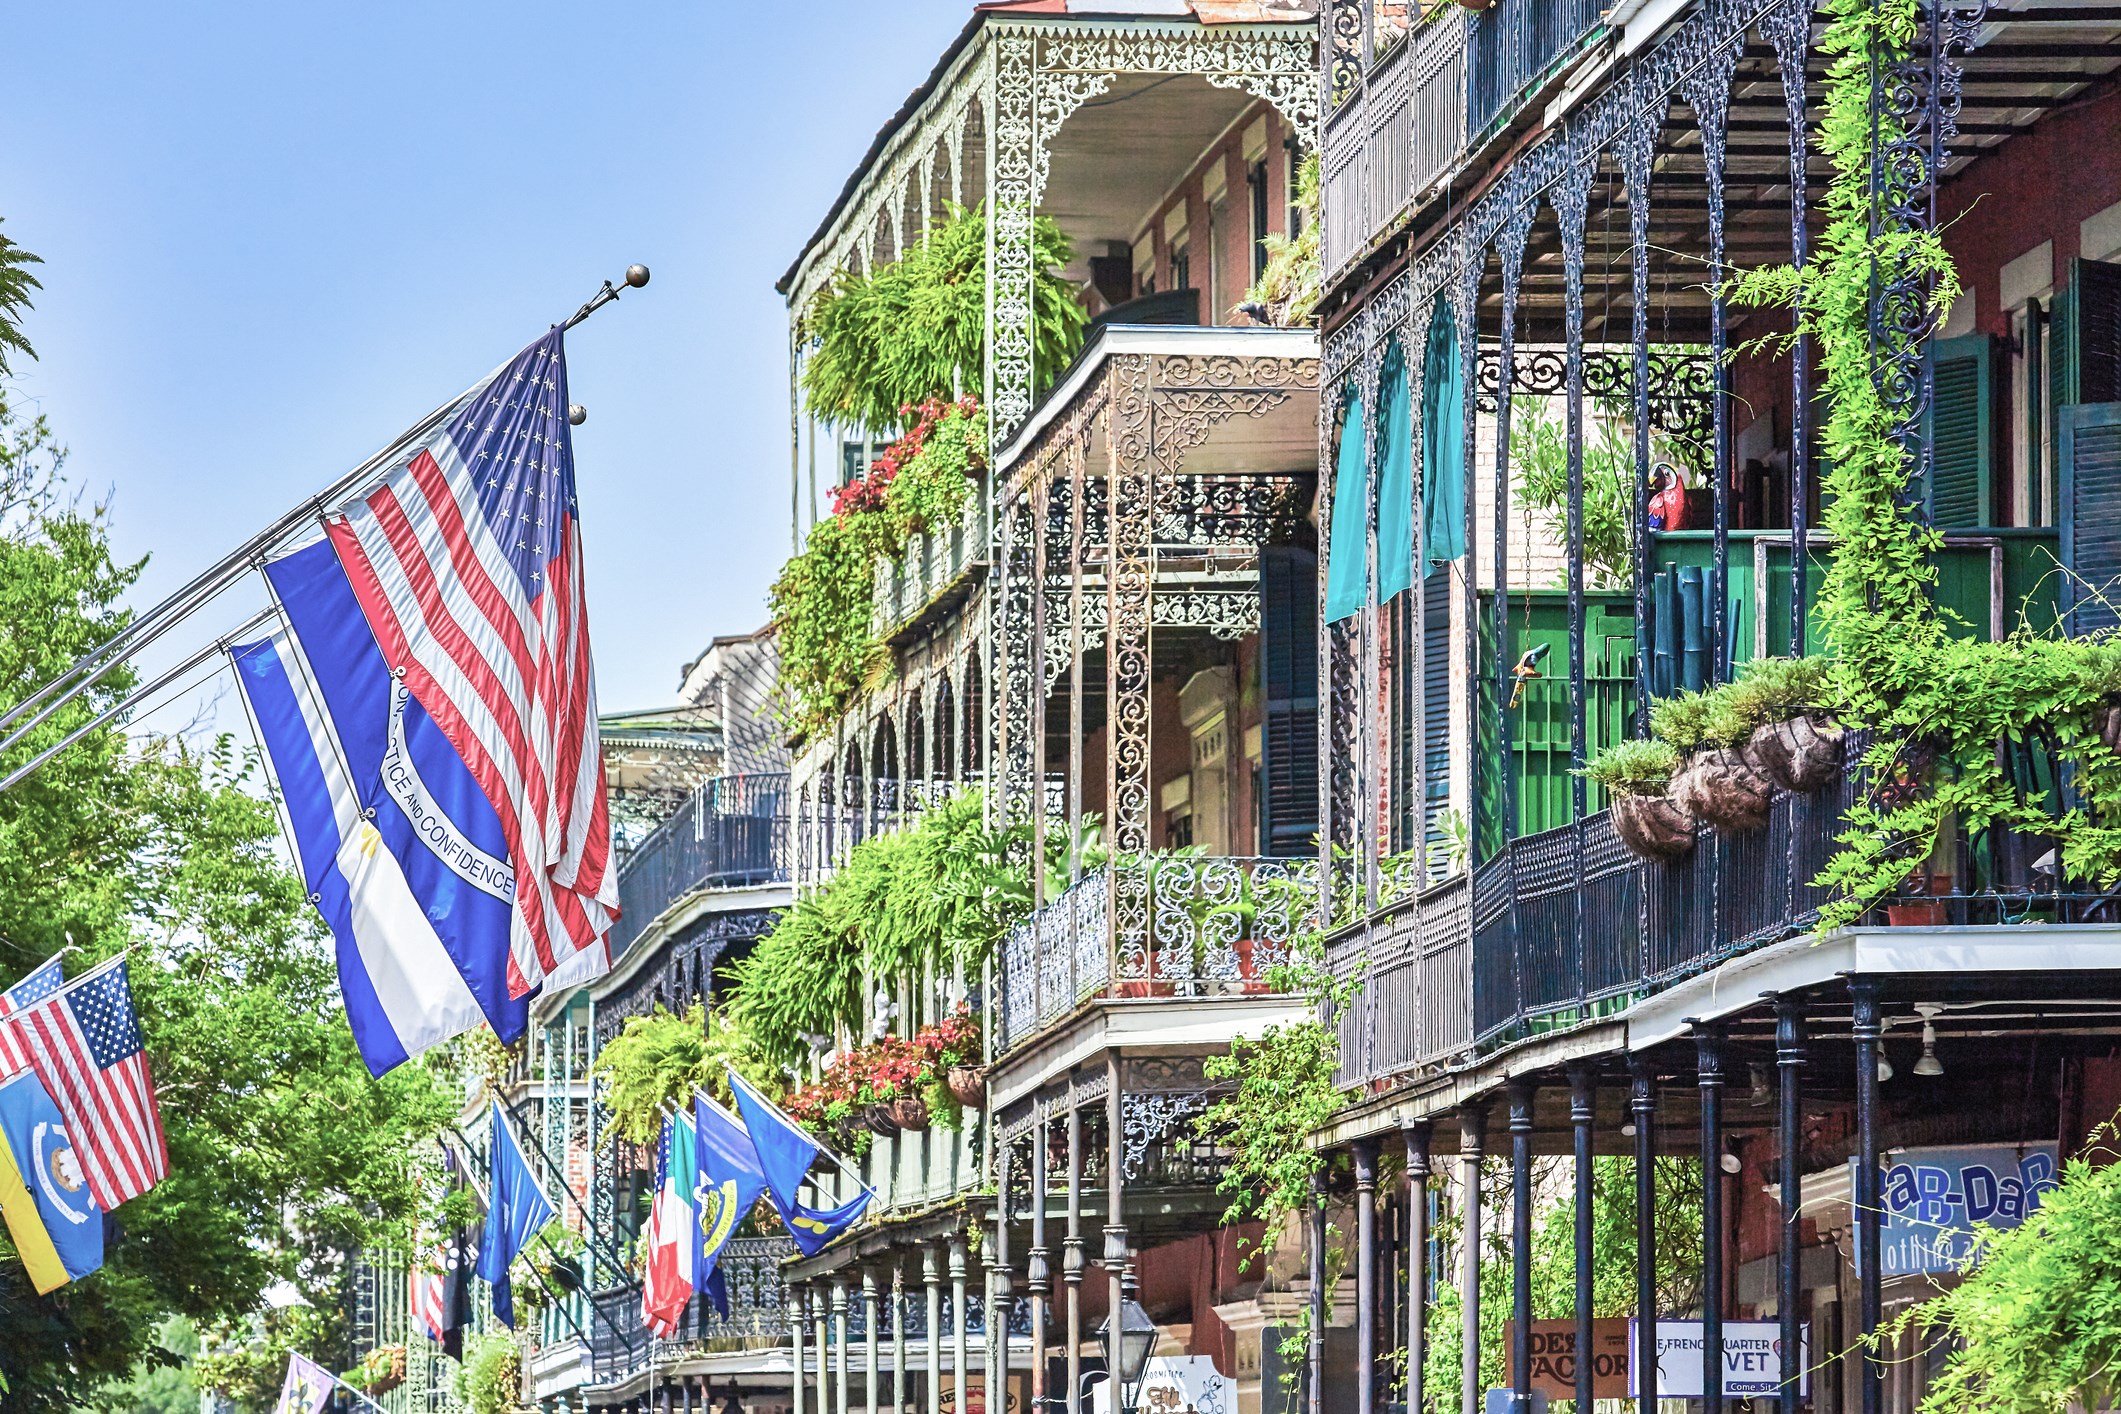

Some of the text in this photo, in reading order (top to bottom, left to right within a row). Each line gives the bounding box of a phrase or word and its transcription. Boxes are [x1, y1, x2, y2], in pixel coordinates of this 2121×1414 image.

[404, 793, 424, 819] AND
[420, 815, 515, 895] CONFIDENCE
[1667, 1340, 1704, 1350] FRENC
[1723, 1340, 1769, 1350] UARTER
[1727, 1352, 1769, 1371] VET
